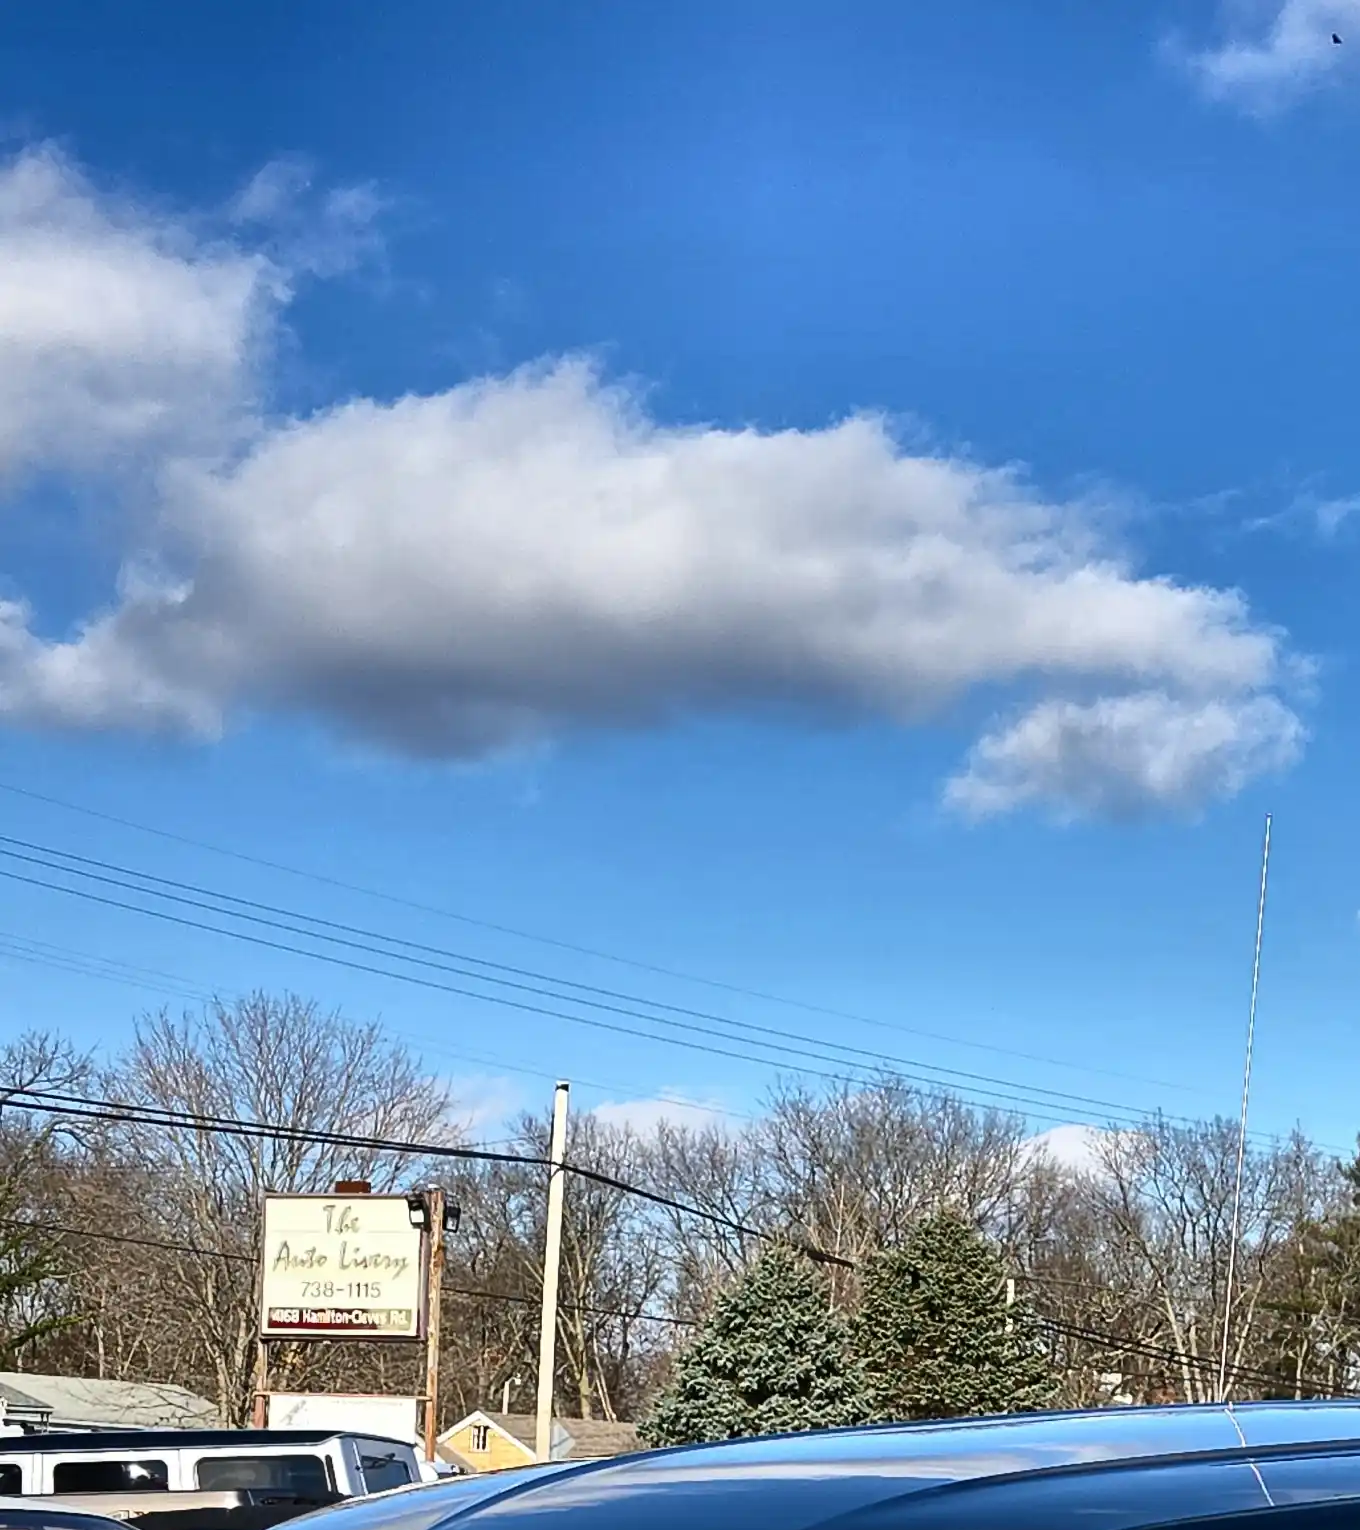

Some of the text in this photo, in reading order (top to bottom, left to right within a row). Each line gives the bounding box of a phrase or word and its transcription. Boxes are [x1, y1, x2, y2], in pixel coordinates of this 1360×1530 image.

[323, 1205, 360, 1234] The
[273, 1240, 410, 1280] Auto Livery
[301, 1281, 382, 1299] 738-1115
